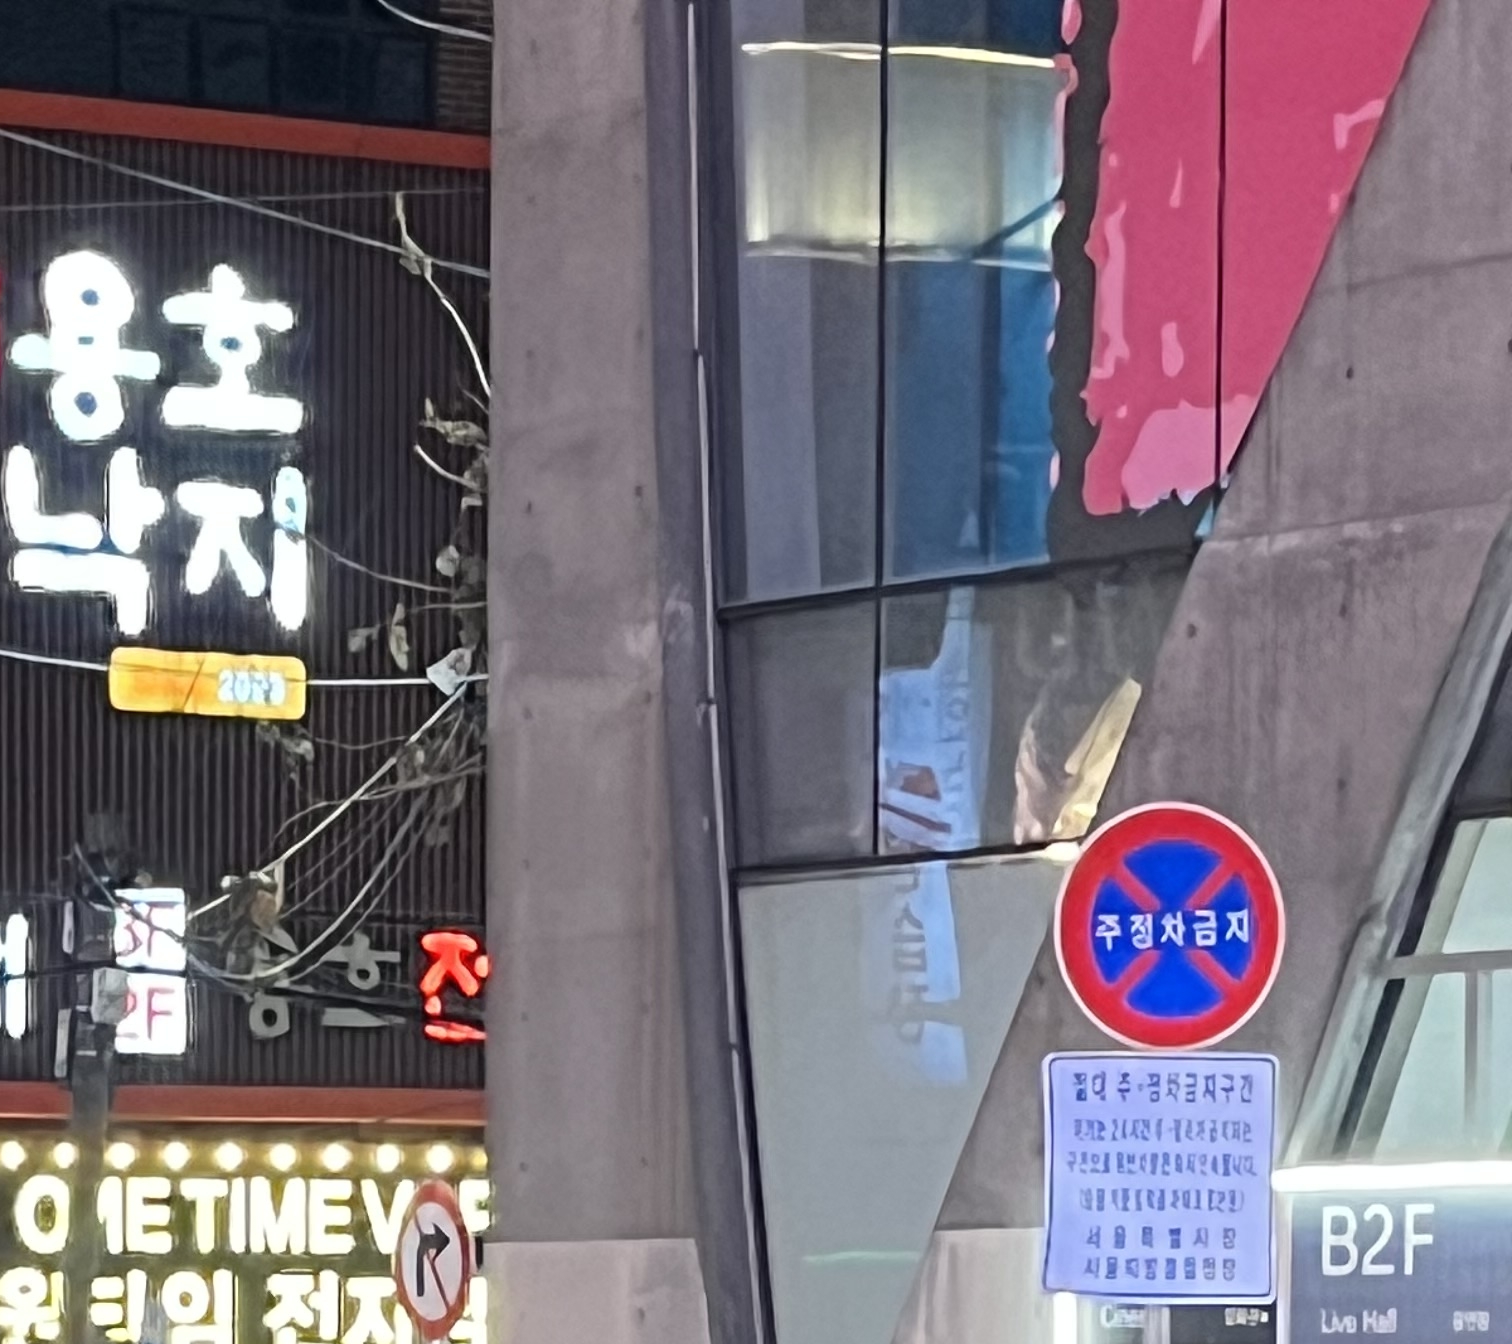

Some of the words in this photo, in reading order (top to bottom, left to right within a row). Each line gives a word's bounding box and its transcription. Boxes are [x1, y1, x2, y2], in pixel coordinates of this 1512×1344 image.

[9, 250, 306, 441] 용호
[4, 443, 308, 637] 낙지
[1095, 908, 1251, 952] 주정차금지
[180, 1175, 356, 1256] TIME
[1321, 1203, 1436, 1278] B2F
